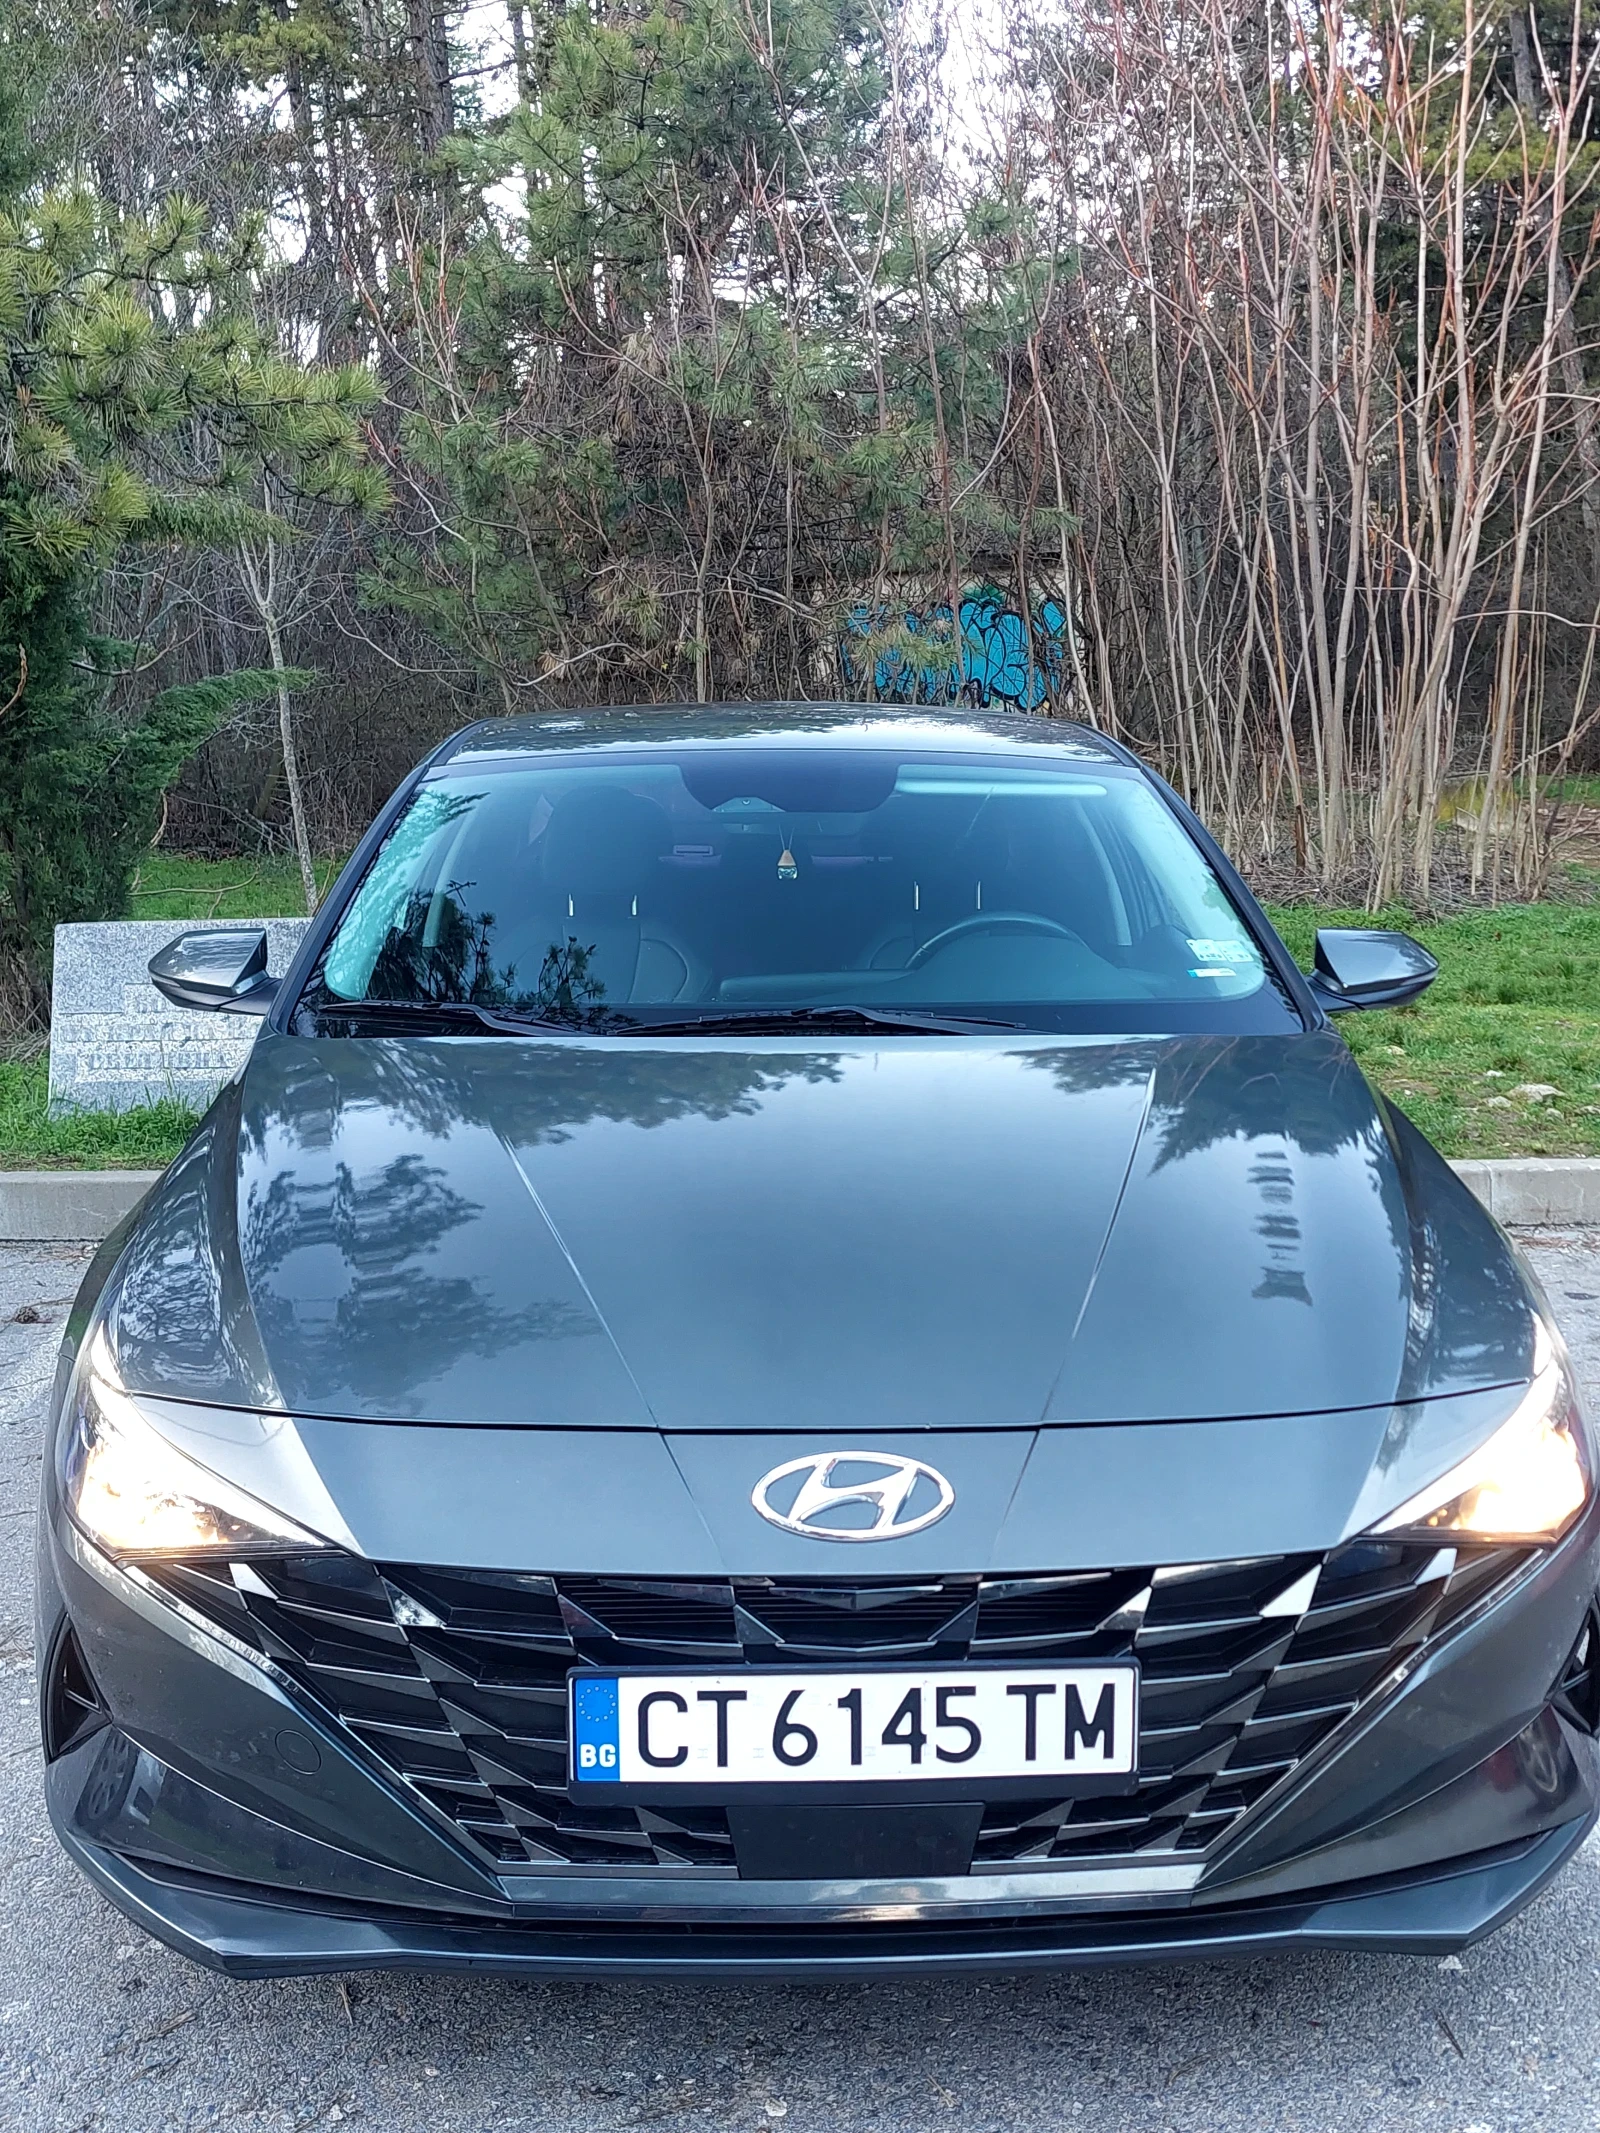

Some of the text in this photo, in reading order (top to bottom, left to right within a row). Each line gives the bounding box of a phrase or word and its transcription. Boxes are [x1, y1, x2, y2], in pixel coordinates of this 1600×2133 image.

[637, 1683, 1116, 1768] CT 6145 TM
[580, 1743, 616, 1768] BG
